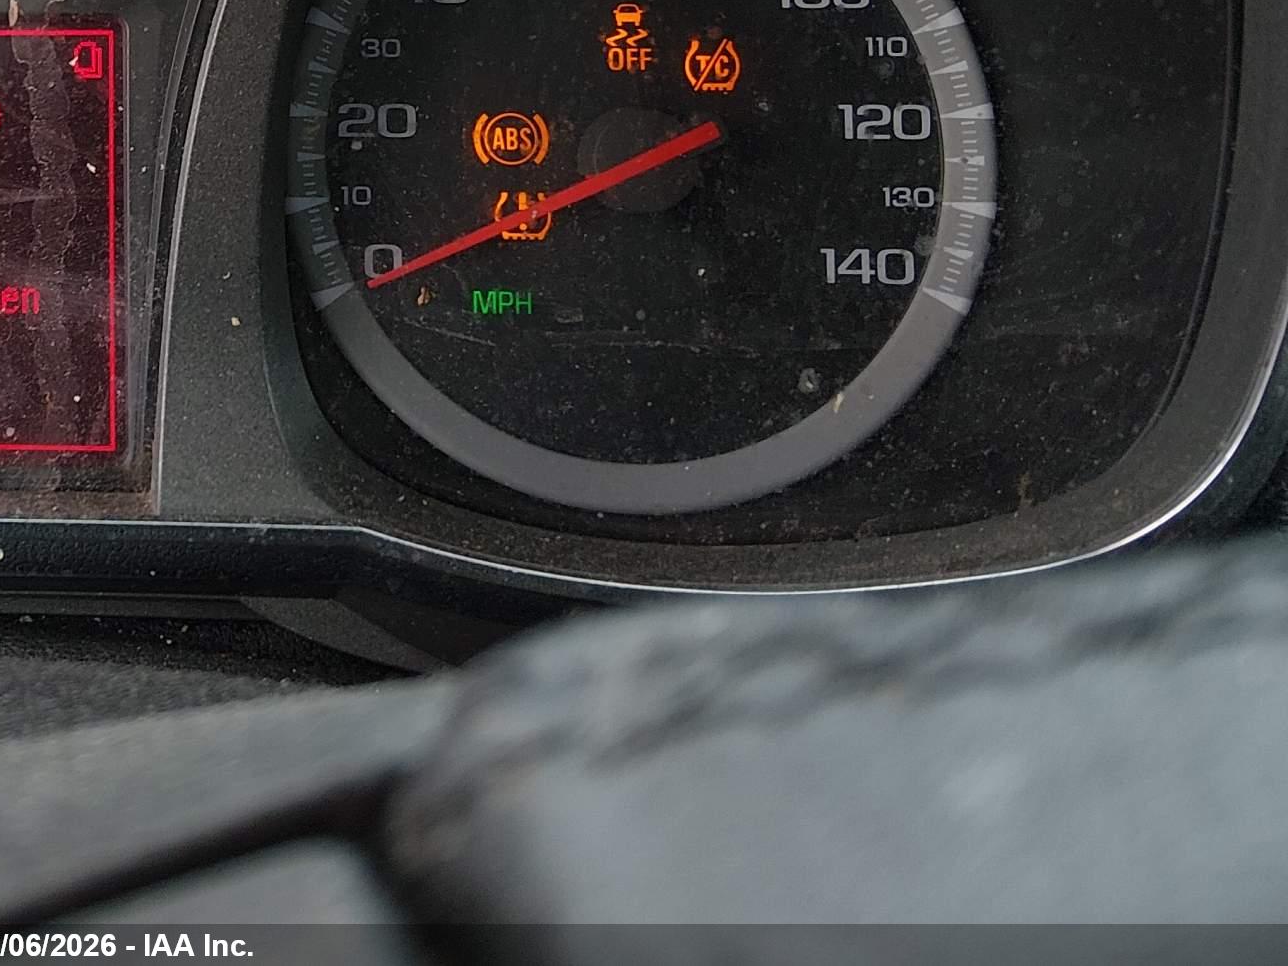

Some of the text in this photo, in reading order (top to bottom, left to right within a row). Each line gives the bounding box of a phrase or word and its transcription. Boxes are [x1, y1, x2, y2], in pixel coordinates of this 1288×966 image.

[361, 38, 401, 58] 30
[865, 37, 908, 57] 110
[608, 48, 653, 71] OFF
[338, 103, 417, 138] 20
[837, 104, 931, 140] 120
[492, 127, 532, 151] ABS
[340, 186, 372, 206] 10
[882, 187, 935, 208] 130
[364, 244, 403, 280] 0
[820, 248, 915, 285] 140
[472, 290, 533, 315] MPH
